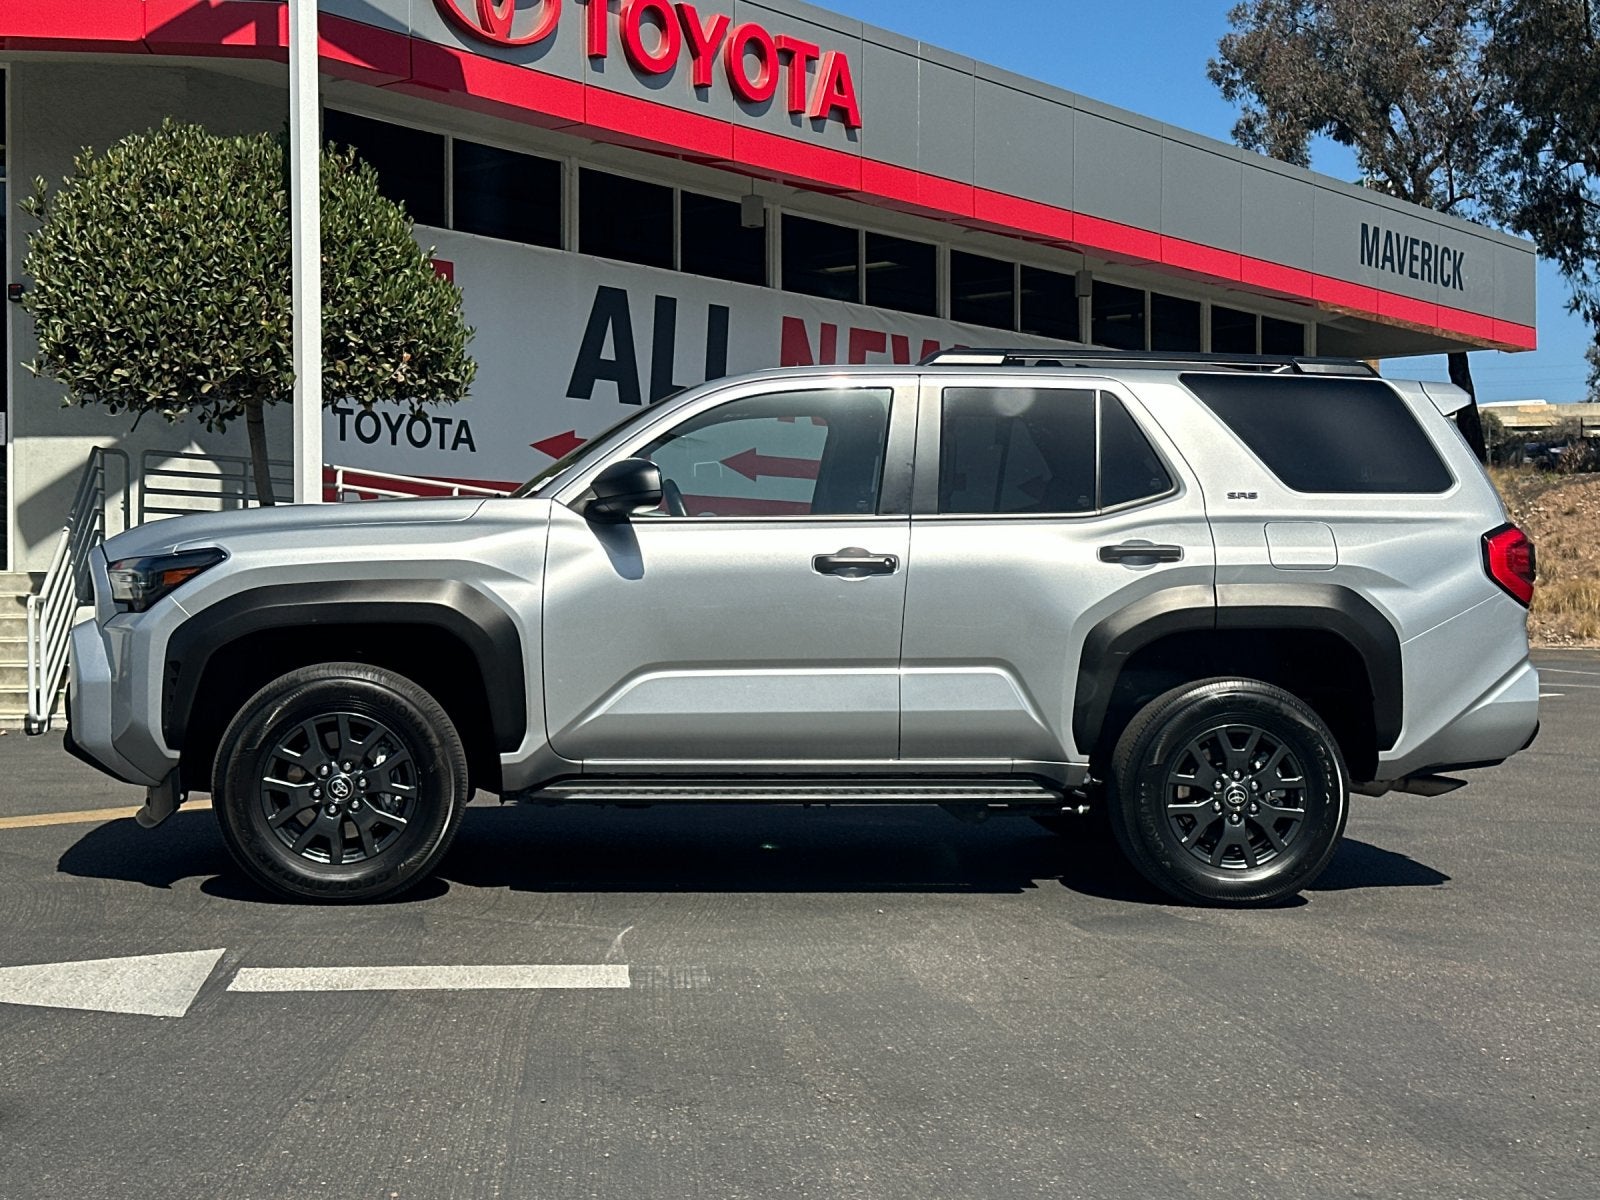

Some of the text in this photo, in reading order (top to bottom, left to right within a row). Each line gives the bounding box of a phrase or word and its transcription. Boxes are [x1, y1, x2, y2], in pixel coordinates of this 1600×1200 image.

[585, 0, 862, 128] TOYOTA
[1360, 222, 1464, 291] MAVERICK
[333, 406, 477, 452] TOYOTA
